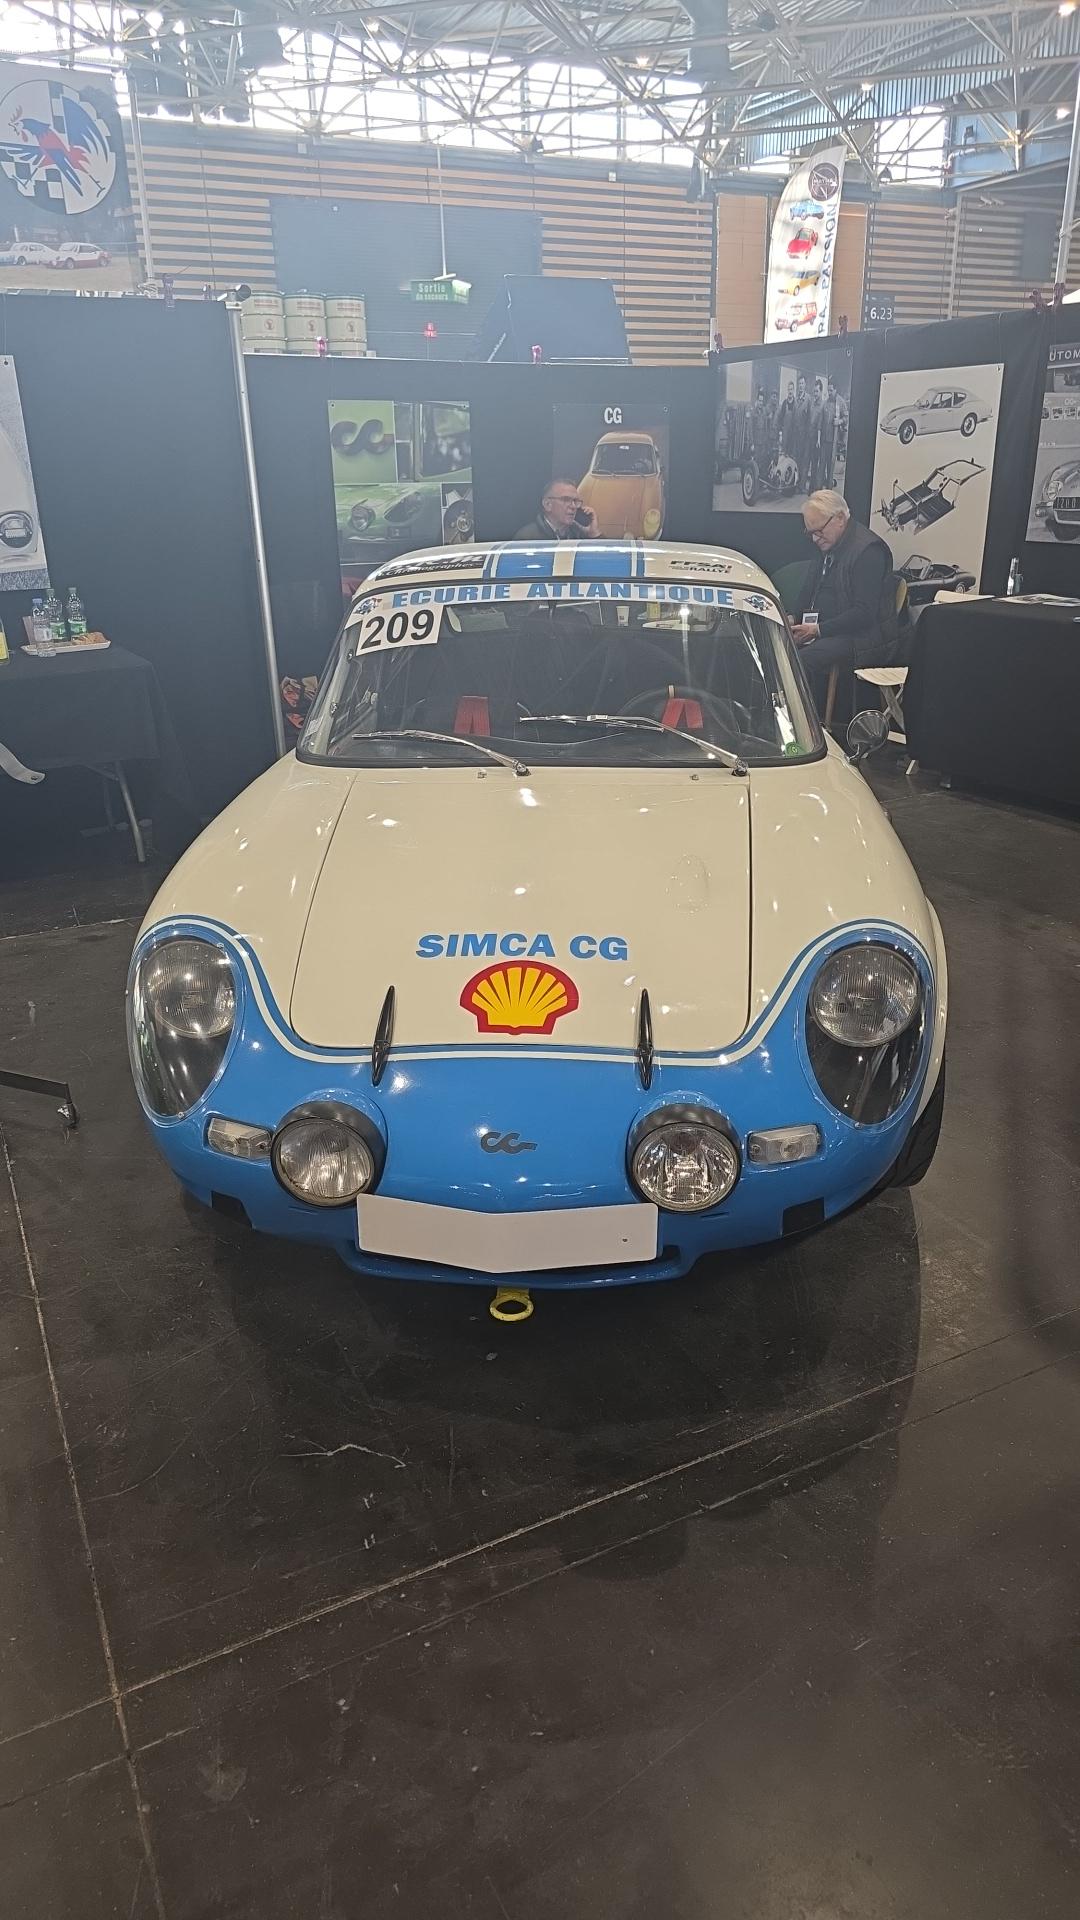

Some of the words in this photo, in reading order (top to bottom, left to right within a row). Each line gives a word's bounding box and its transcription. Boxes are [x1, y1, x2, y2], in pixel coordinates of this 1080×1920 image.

[418, 282, 446, 293] Sortie
[870, 307, 893, 321] 6.23
[604, 407, 623, 424] CG
[392, 583, 511, 608] ECURIE
[526, 583, 734, 606] ATLANTIQUE
[360, 609, 435, 650] 209
[416, 933, 556, 959] SIMCA
[569, 935, 628, 961] CG
